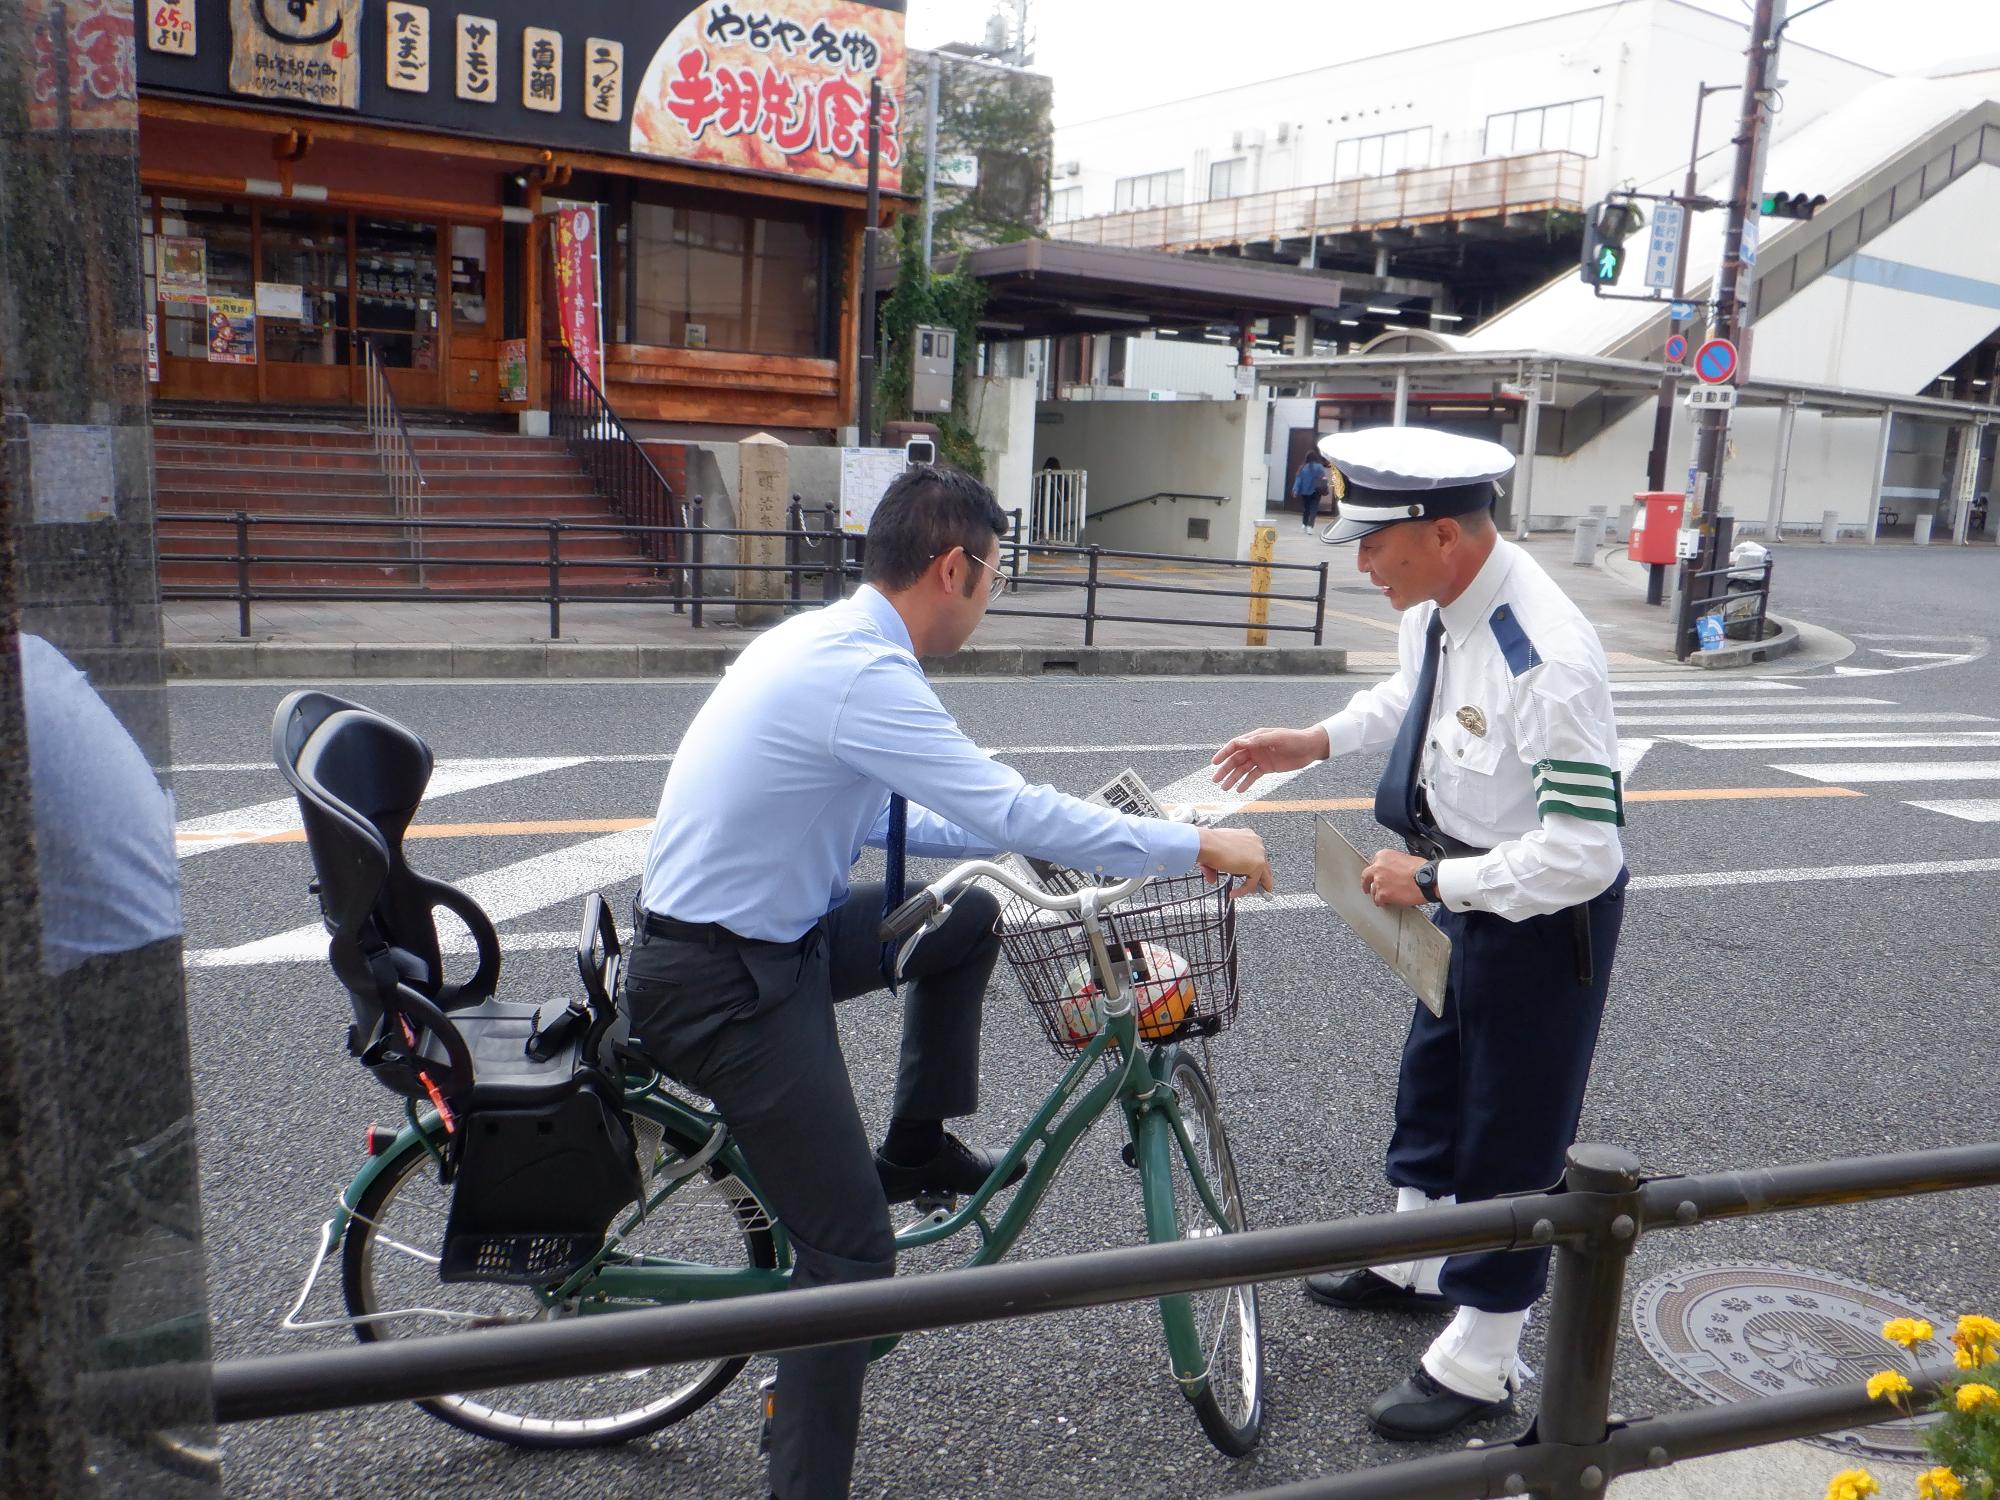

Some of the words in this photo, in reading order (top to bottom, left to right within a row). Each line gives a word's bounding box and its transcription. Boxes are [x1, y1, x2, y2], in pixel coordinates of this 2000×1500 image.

[157, 29, 184, 48] より
[394, 11, 426, 81] たまご
[465, 23, 491, 93] サーモン
[530, 38, 556, 101] 真鯛
[593, 47, 618, 112] うなぎ
[1692, 391, 1730, 403] 自動車
